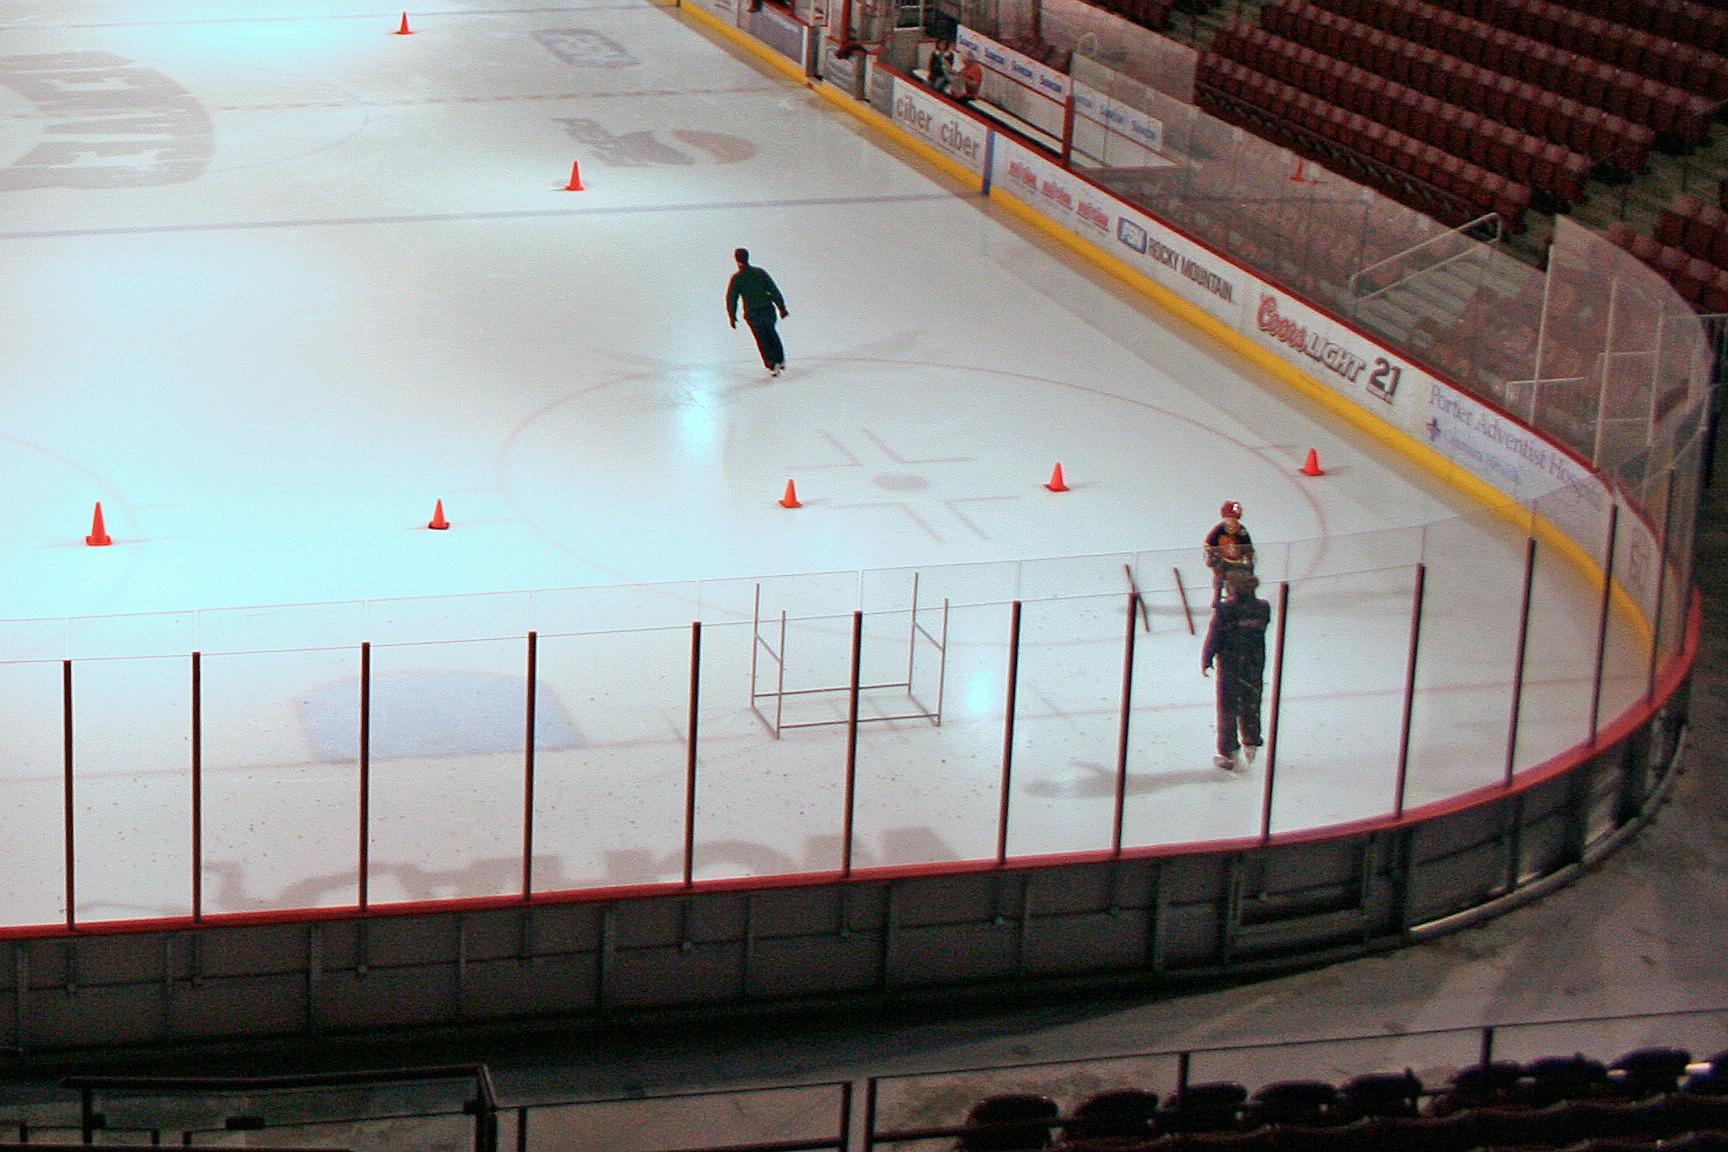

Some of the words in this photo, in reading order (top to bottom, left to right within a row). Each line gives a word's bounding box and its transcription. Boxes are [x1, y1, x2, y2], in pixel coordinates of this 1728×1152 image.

[896, 95, 933, 131] ciber
[940, 120, 980, 161] ciber
[1148, 237, 1179, 273] ROCKY
[1180, 255, 1233, 303] MOUNTAIN
[1256, 292, 1308, 353] Coors
[1304, 330, 1367, 384] LIGHT
[1368, 355, 1401, 398] 21
[1429, 383, 1472, 426] Porter
